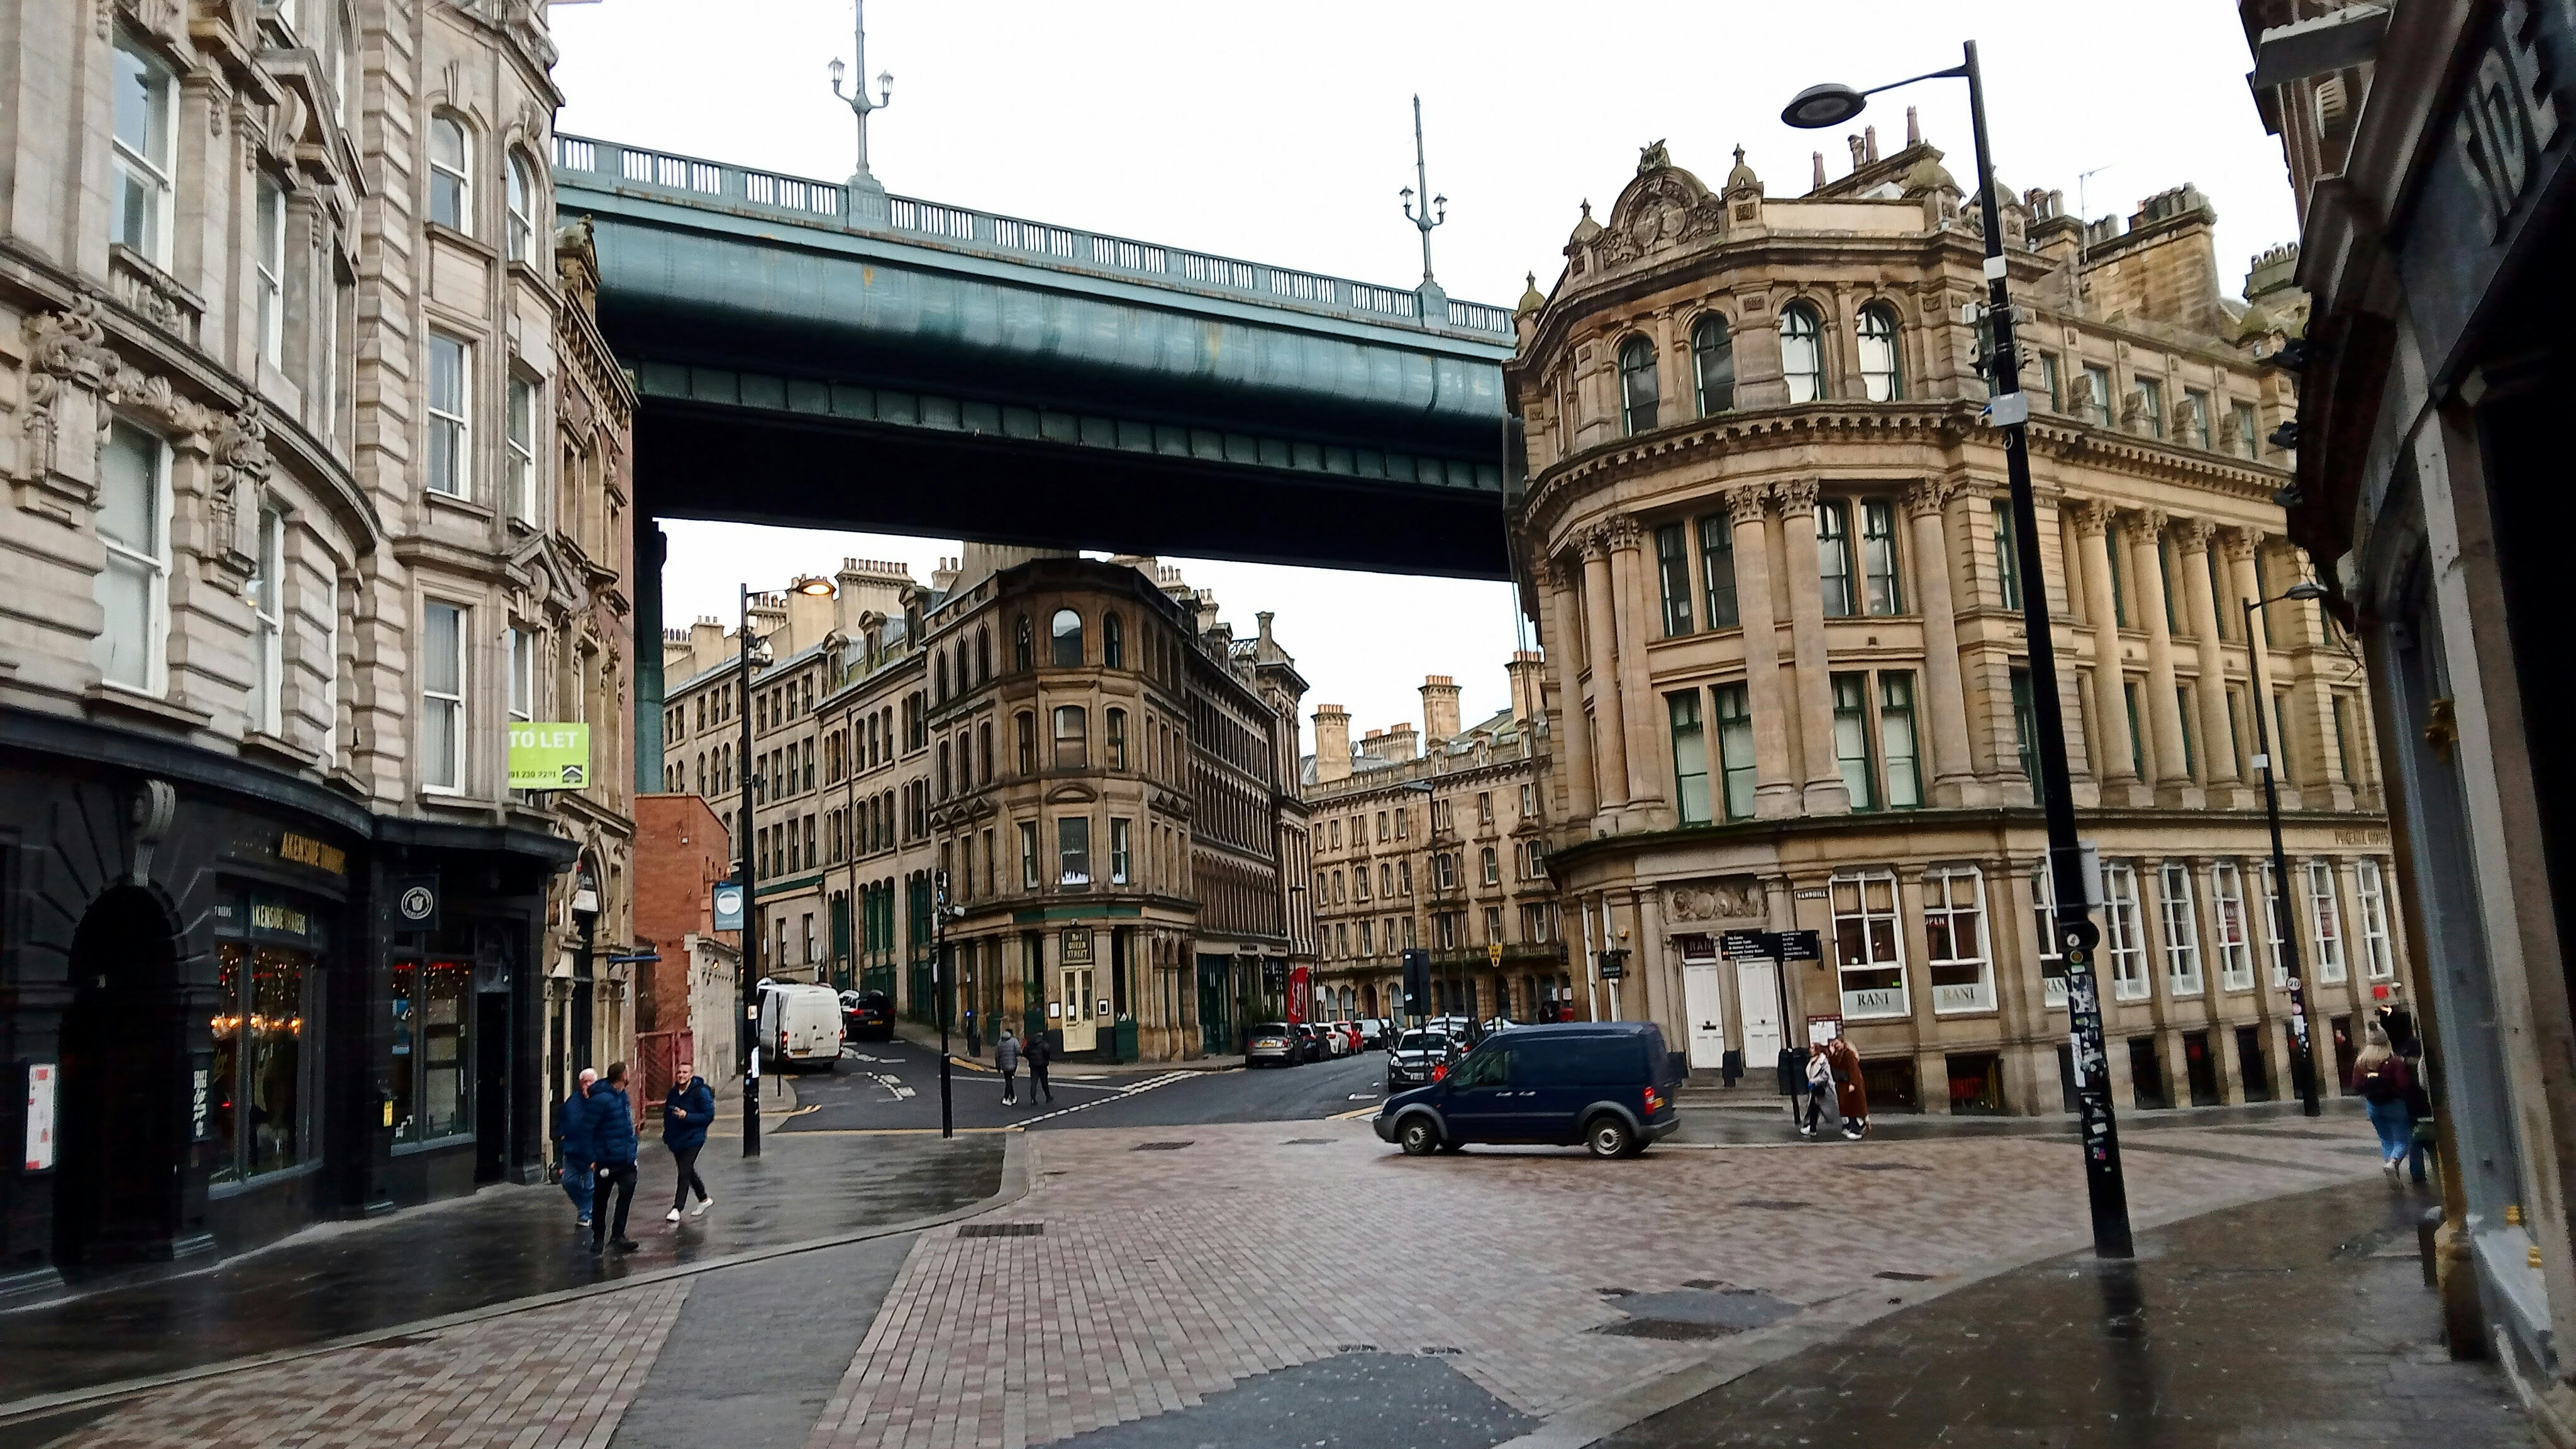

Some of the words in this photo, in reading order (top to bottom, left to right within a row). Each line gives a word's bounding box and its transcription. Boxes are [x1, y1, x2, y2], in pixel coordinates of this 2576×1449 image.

[509, 730, 535, 748] TO
[540, 731, 579, 748] LET
[1857, 992, 1889, 1006] RANI
[1943, 987, 1975, 1001] RANI
